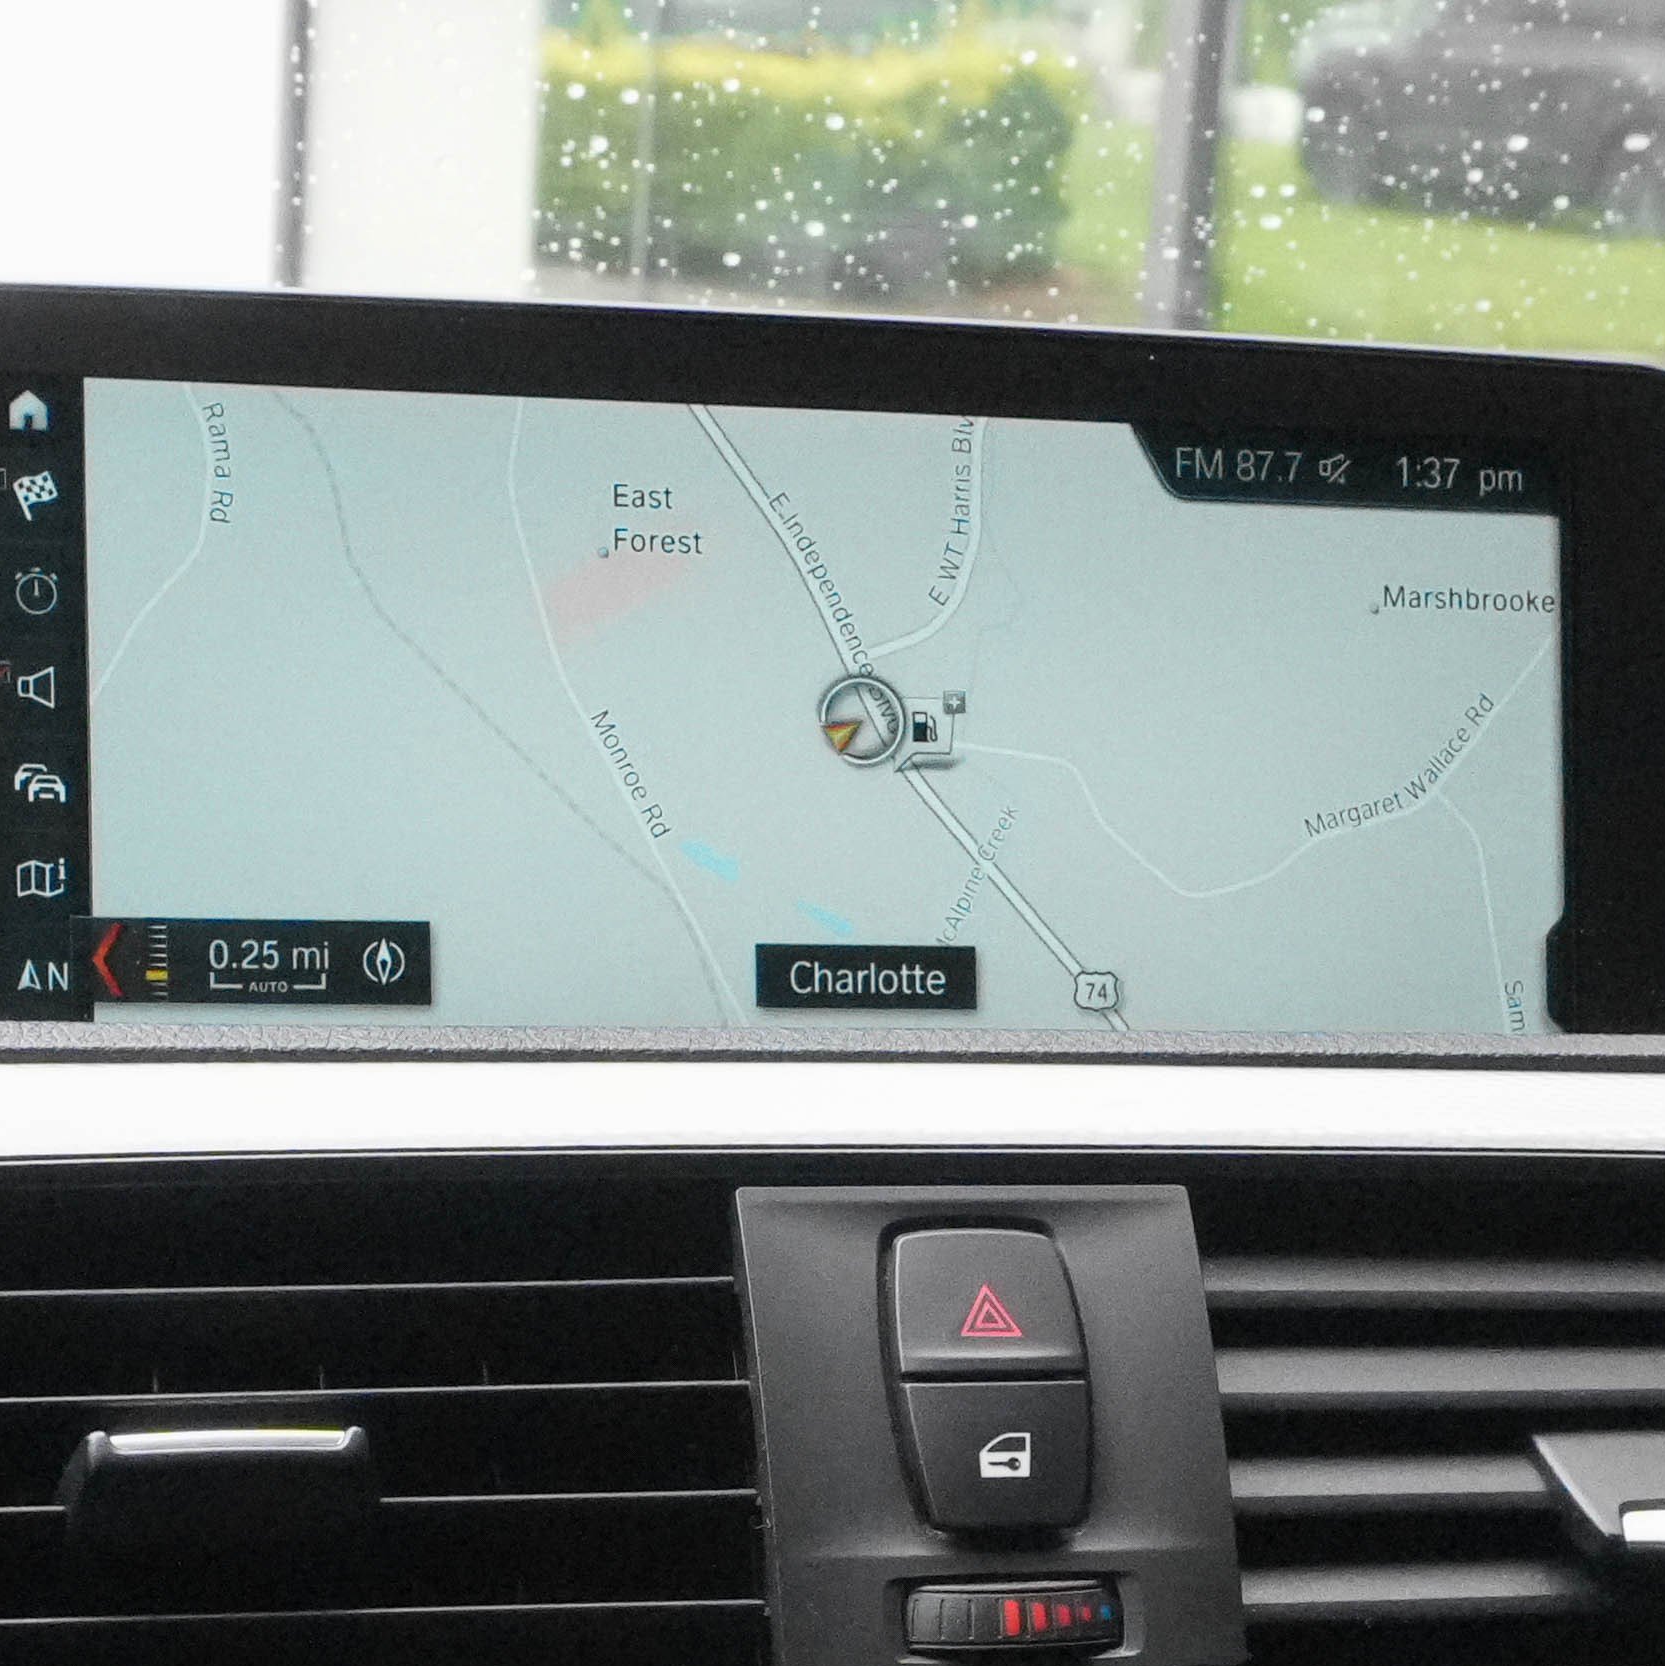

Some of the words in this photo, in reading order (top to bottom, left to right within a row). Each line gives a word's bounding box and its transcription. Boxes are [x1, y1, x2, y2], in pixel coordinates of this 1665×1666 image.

[202, 402, 232, 478] Rama
[1176, 447, 1223, 478] FM
[1237, 449, 1302, 482] 87.7
[1398, 457, 1460, 488] 1:37
[1480, 470, 1522, 496] pm
[210, 490, 234, 523] Rd
[614, 484, 671, 509] East
[951, 464, 972, 535] Harris
[612, 528, 703, 557] Forest
[938, 542, 964, 581] WT
[769, 492, 790, 512] E
[783, 513, 873, 676] Independence
[928, 585, 950, 606] E
[1382, 584, 1556, 613] Marshbrooke
[591, 709, 647, 800] Monroe
[641, 804, 672, 838] Rd
[1304, 792, 1403, 837] Margaret
[1404, 726, 1471, 801] Wallace
[1464, 692, 1495, 728] Rd
[977, 805, 1021, 862] Creek
[209, 939, 280, 971] 0.25
[291, 940, 331, 970] mi
[48, 962, 68, 990] N
[249, 981, 288, 993] AUTO
[790, 961, 945, 995] Charlotte
[1086, 983, 1107, 1001] 74
[1504, 980, 1525, 1032] Sam
